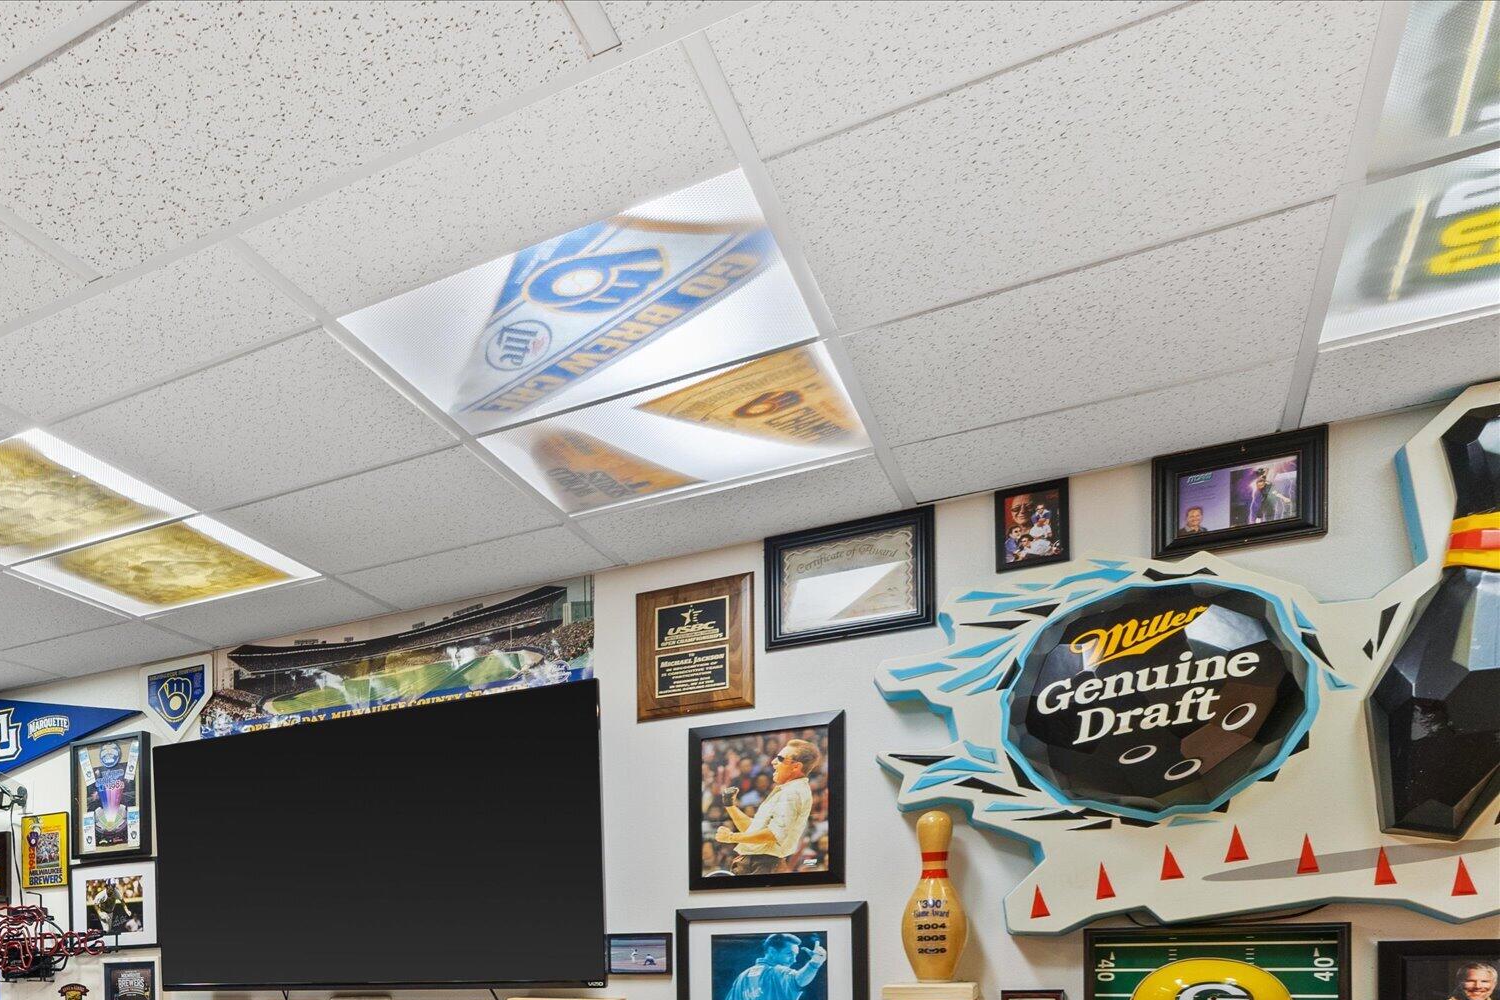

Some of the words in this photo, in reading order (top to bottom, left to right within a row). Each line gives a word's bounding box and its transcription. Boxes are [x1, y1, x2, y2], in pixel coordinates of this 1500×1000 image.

[556, 306, 684, 381] BREW
[797, 550, 845, 574] Certificate
[845, 548, 857, 558] of
[858, 543, 899, 558] Award
[667, 620, 717, 636] USBC
[1070, 606, 1208, 665] Miller
[660, 659, 693, 668] MICHAEL
[693, 653, 725, 665] JACKSON
[1036, 650, 1260, 715] Genuine
[1072, 686, 1221, 745] Draft
[27, 716, 70, 736] MARQUETTE
[29, 867, 63, 876] MILWAUKEE
[29, 874, 63, 886] BREWERS
[916, 922, 947, 930] 2004
[916, 934, 947, 942] 2005
[1099, 958, 1115, 982] 40
[1313, 957, 1335, 982] 40
[117, 977, 145, 989] BREWERS
